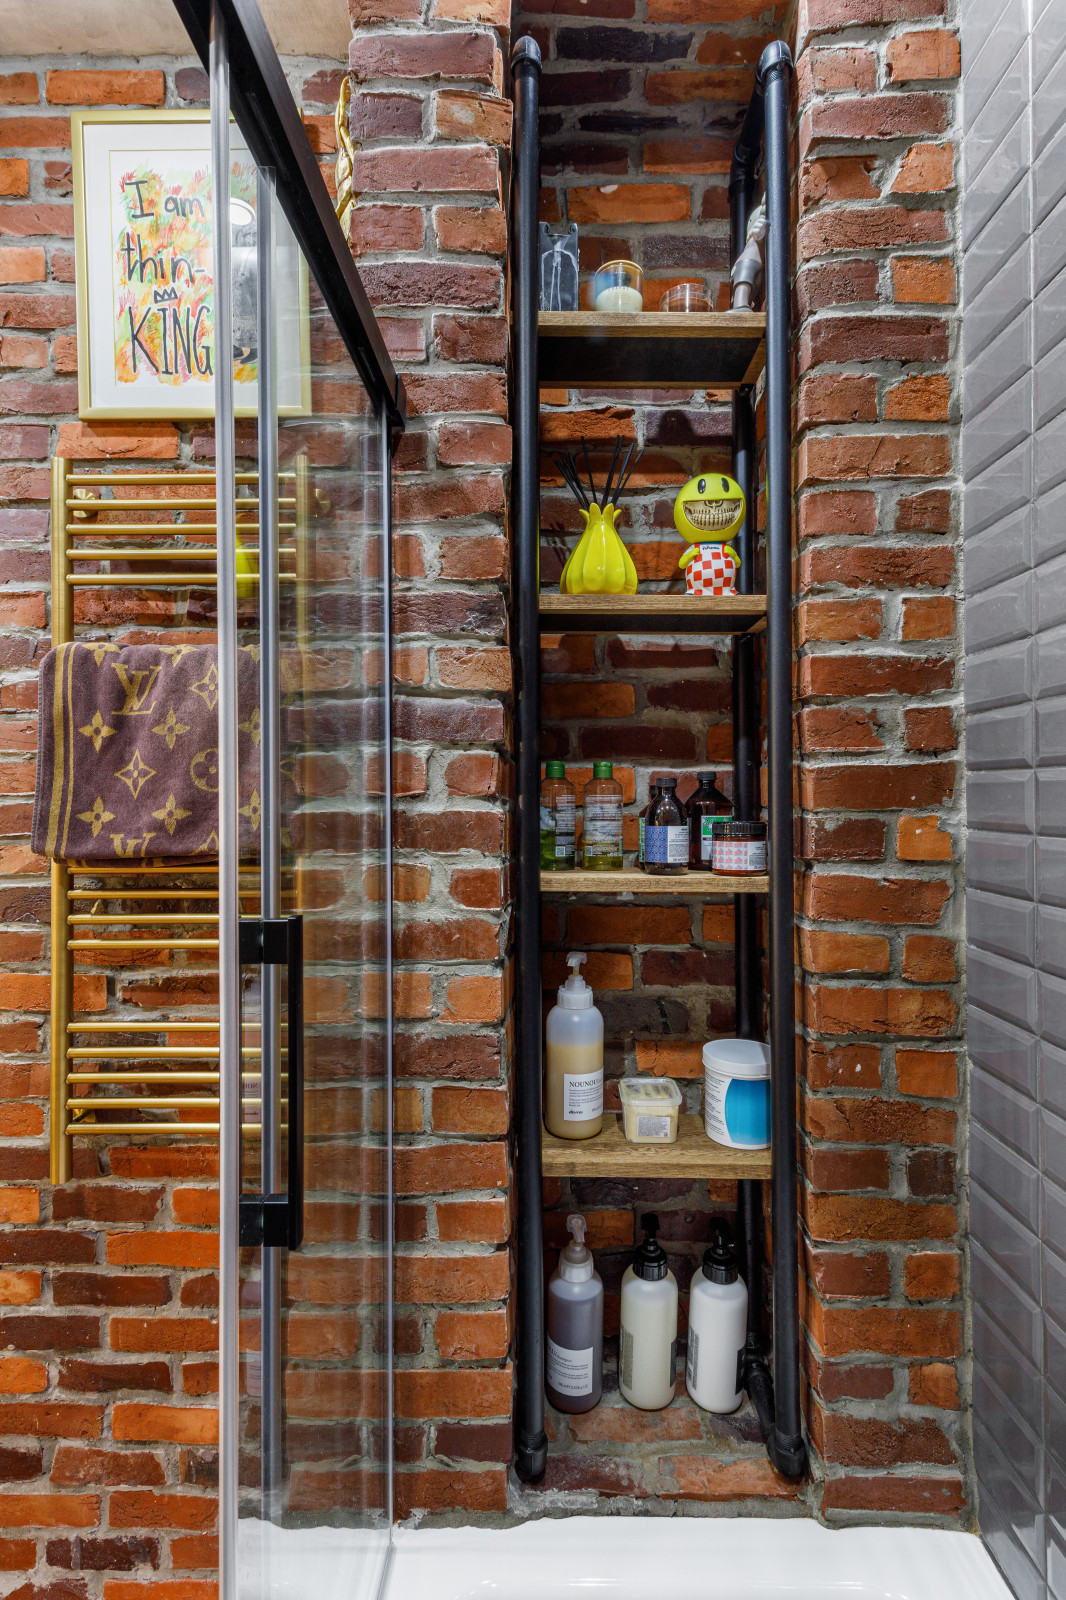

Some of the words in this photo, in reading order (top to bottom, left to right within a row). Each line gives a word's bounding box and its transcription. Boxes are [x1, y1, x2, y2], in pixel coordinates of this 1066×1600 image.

[124, 179, 154, 219] I
[163, 195, 204, 218] am
[121, 232, 205, 284] thin-
[128, 305, 214, 376] KING
